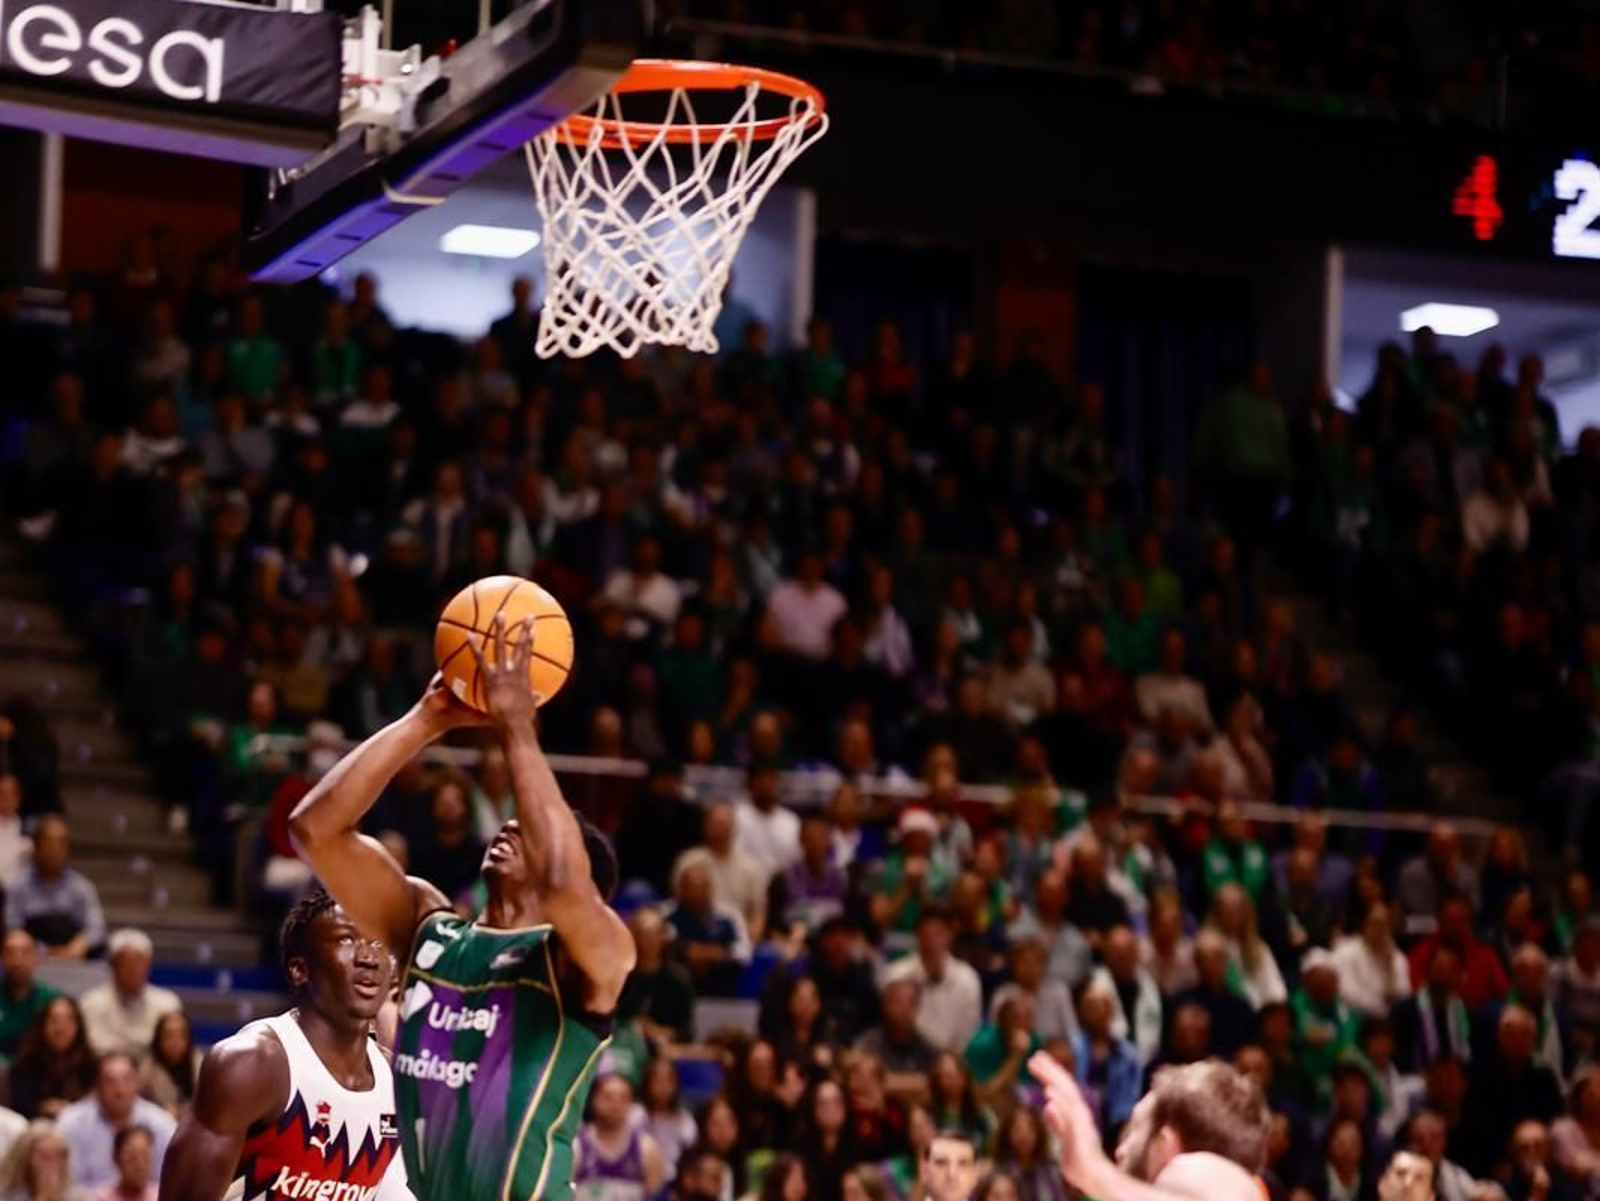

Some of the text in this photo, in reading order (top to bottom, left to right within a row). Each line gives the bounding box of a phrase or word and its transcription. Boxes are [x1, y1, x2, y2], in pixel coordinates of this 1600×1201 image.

[7, 4, 224, 103] esa
[1453, 155, 1503, 240] 4
[1553, 157, 1600, 259] 2
